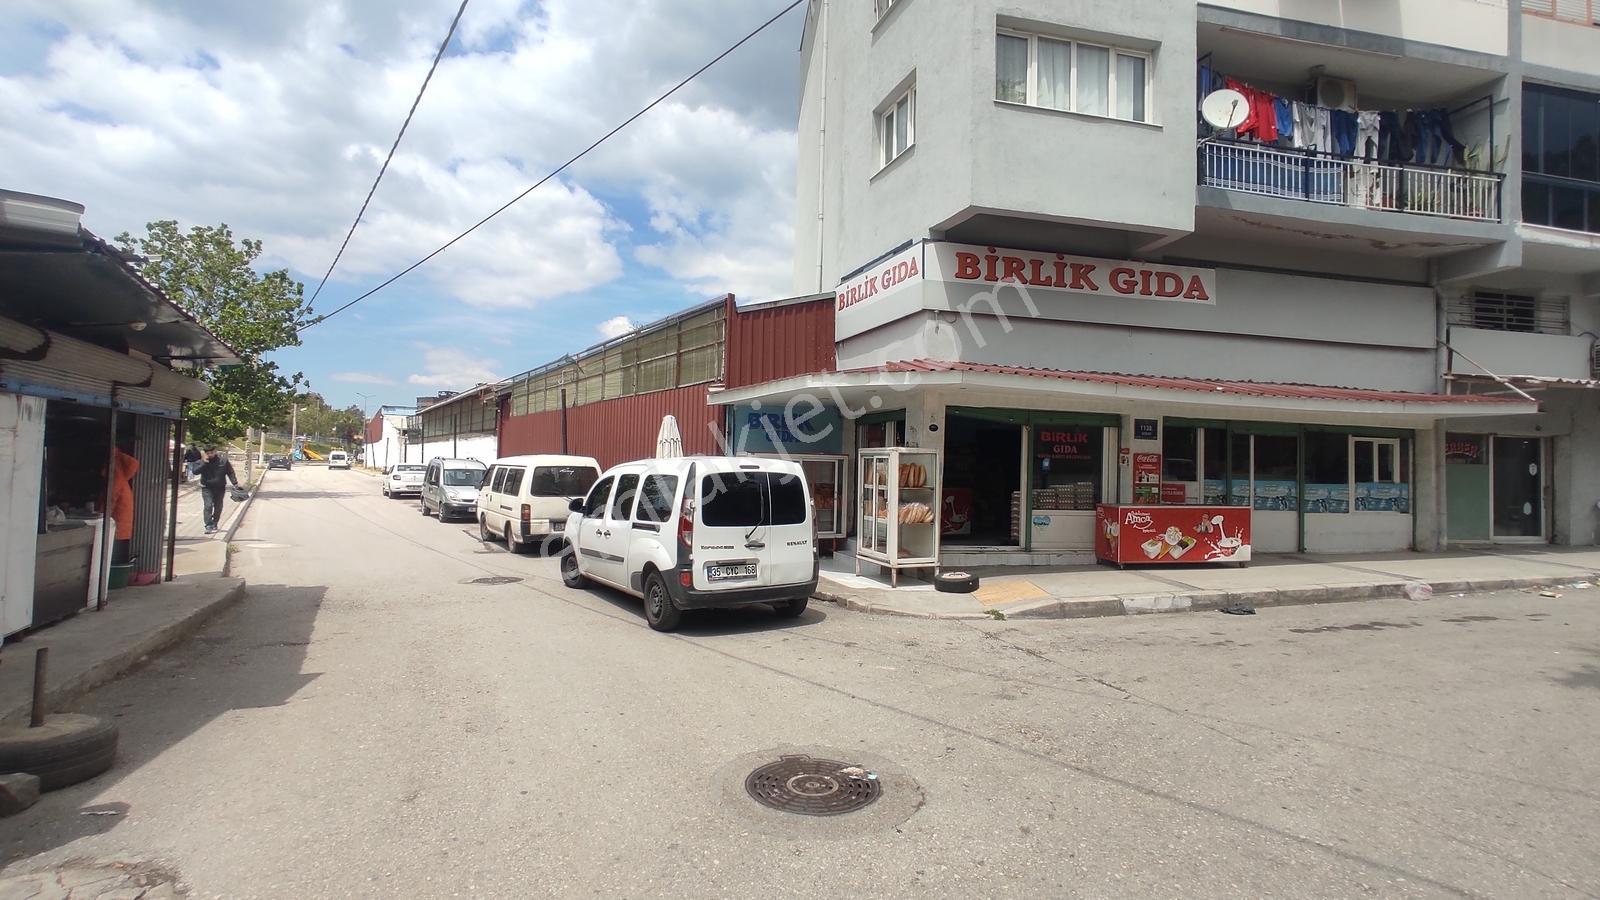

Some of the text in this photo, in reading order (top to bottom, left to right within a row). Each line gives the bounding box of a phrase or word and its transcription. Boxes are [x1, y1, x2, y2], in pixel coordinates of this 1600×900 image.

[838, 256, 919, 311] BİRLİK GIDA
[955, 246, 1209, 300] BİRLİK GIDA
[1053, 445, 1078, 454] GIDA
[711, 565, 756, 577] 35 CYC 168
